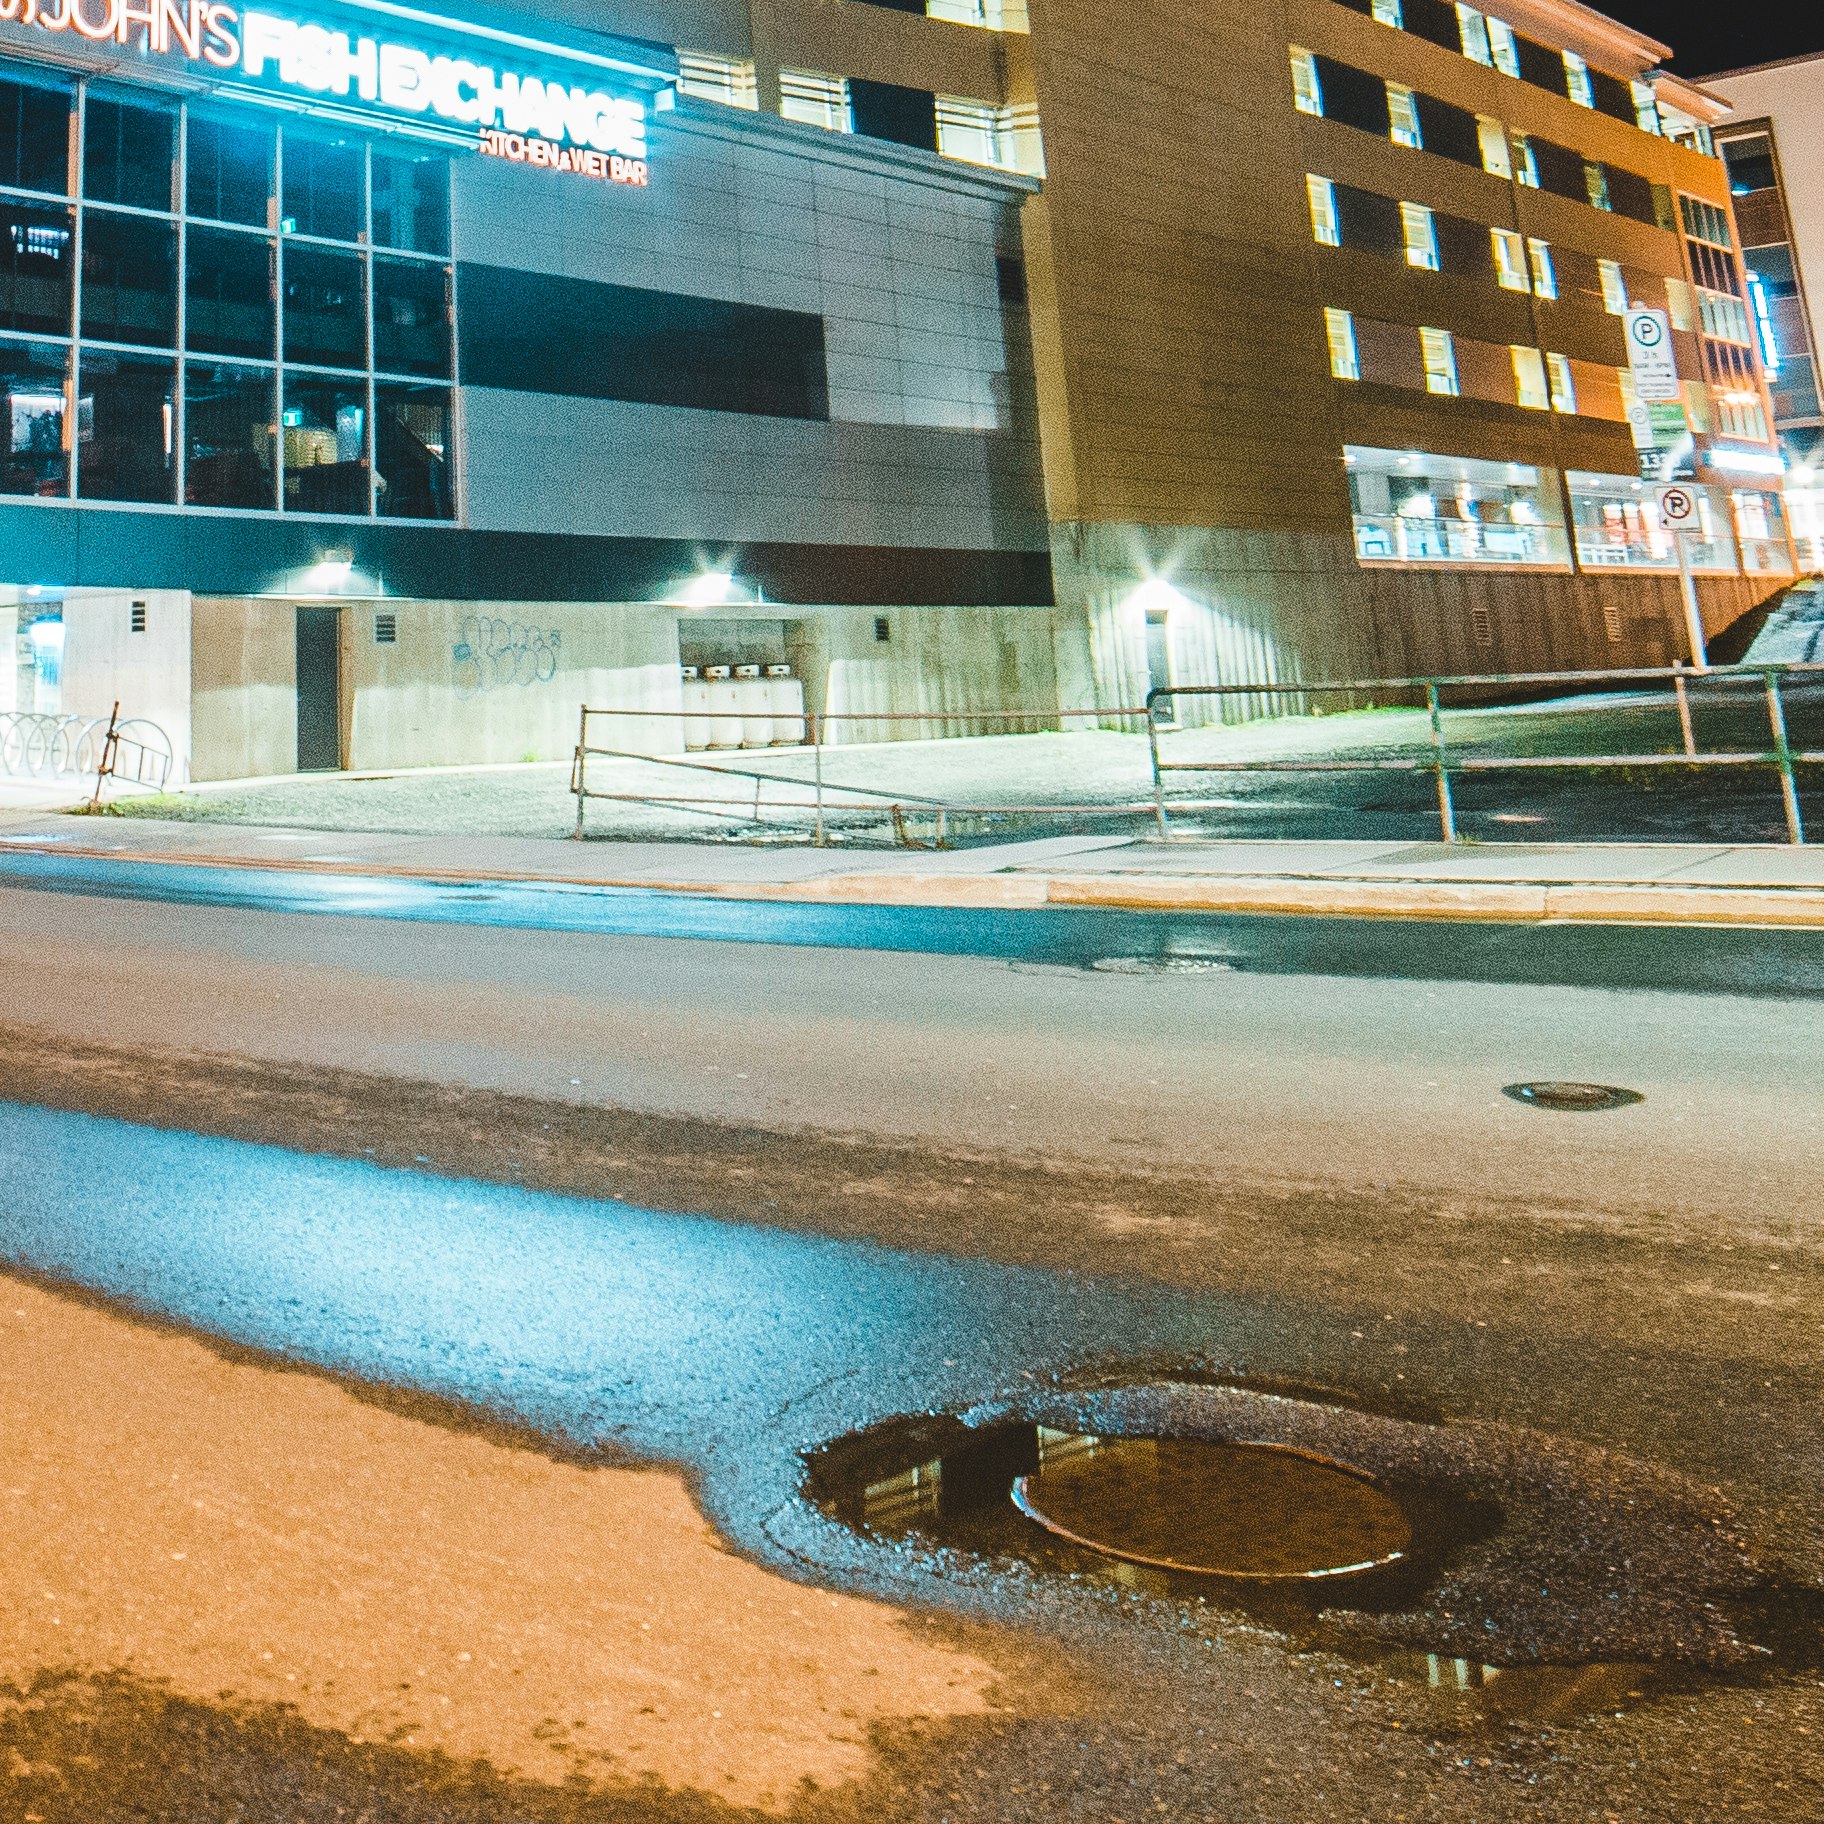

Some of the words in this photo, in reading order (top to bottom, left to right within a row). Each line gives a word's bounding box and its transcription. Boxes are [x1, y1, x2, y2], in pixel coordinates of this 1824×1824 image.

[243, 12, 378, 101] FISH
[380, 44, 648, 159] EXCHANGE
[478, 127, 560, 168] KITCHEN
[570, 147, 610, 178] WET
[610, 155, 648, 187] BAR
